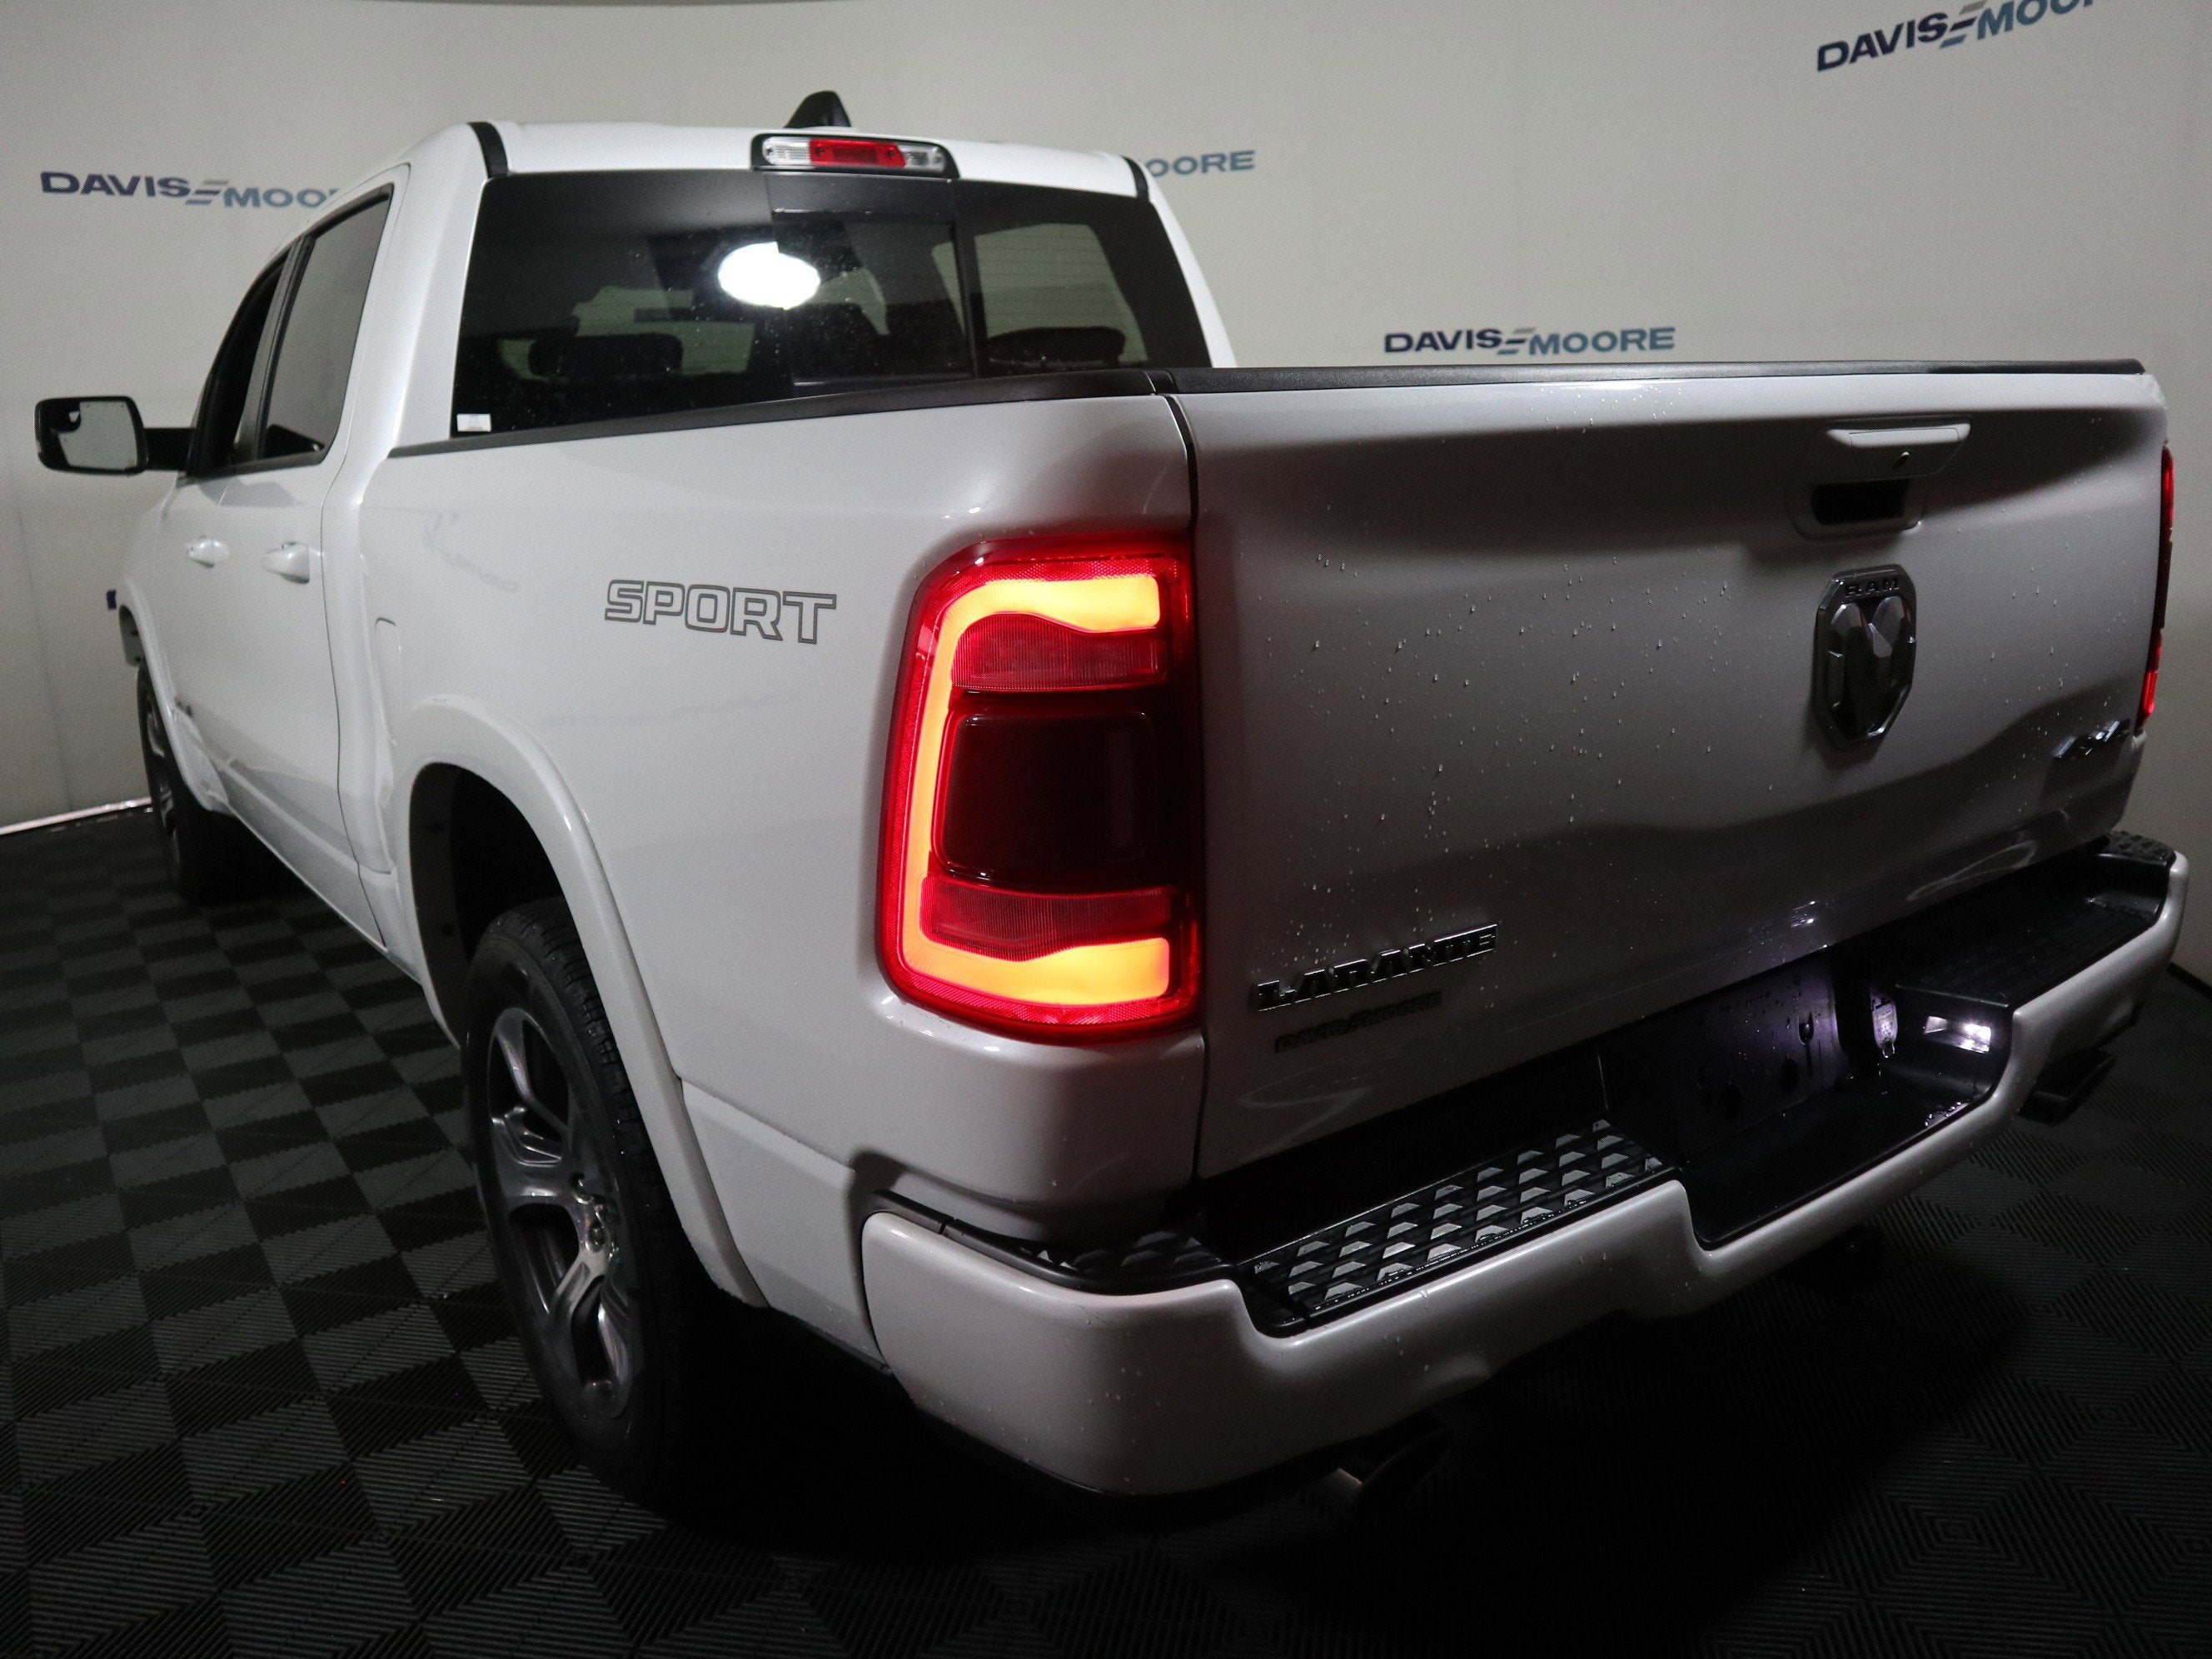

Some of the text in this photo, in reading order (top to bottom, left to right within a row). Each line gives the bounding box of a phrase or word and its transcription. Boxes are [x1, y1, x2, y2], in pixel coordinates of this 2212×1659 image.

[1817, 0, 2094, 72] DAVIS MOO
[41, 171, 340, 209] DAVIS MOO
[1384, 326, 1676, 356] DAVIS MOORE
[604, 579, 837, 645] SPORT
[1250, 923, 1498, 1014] LARAMIE
